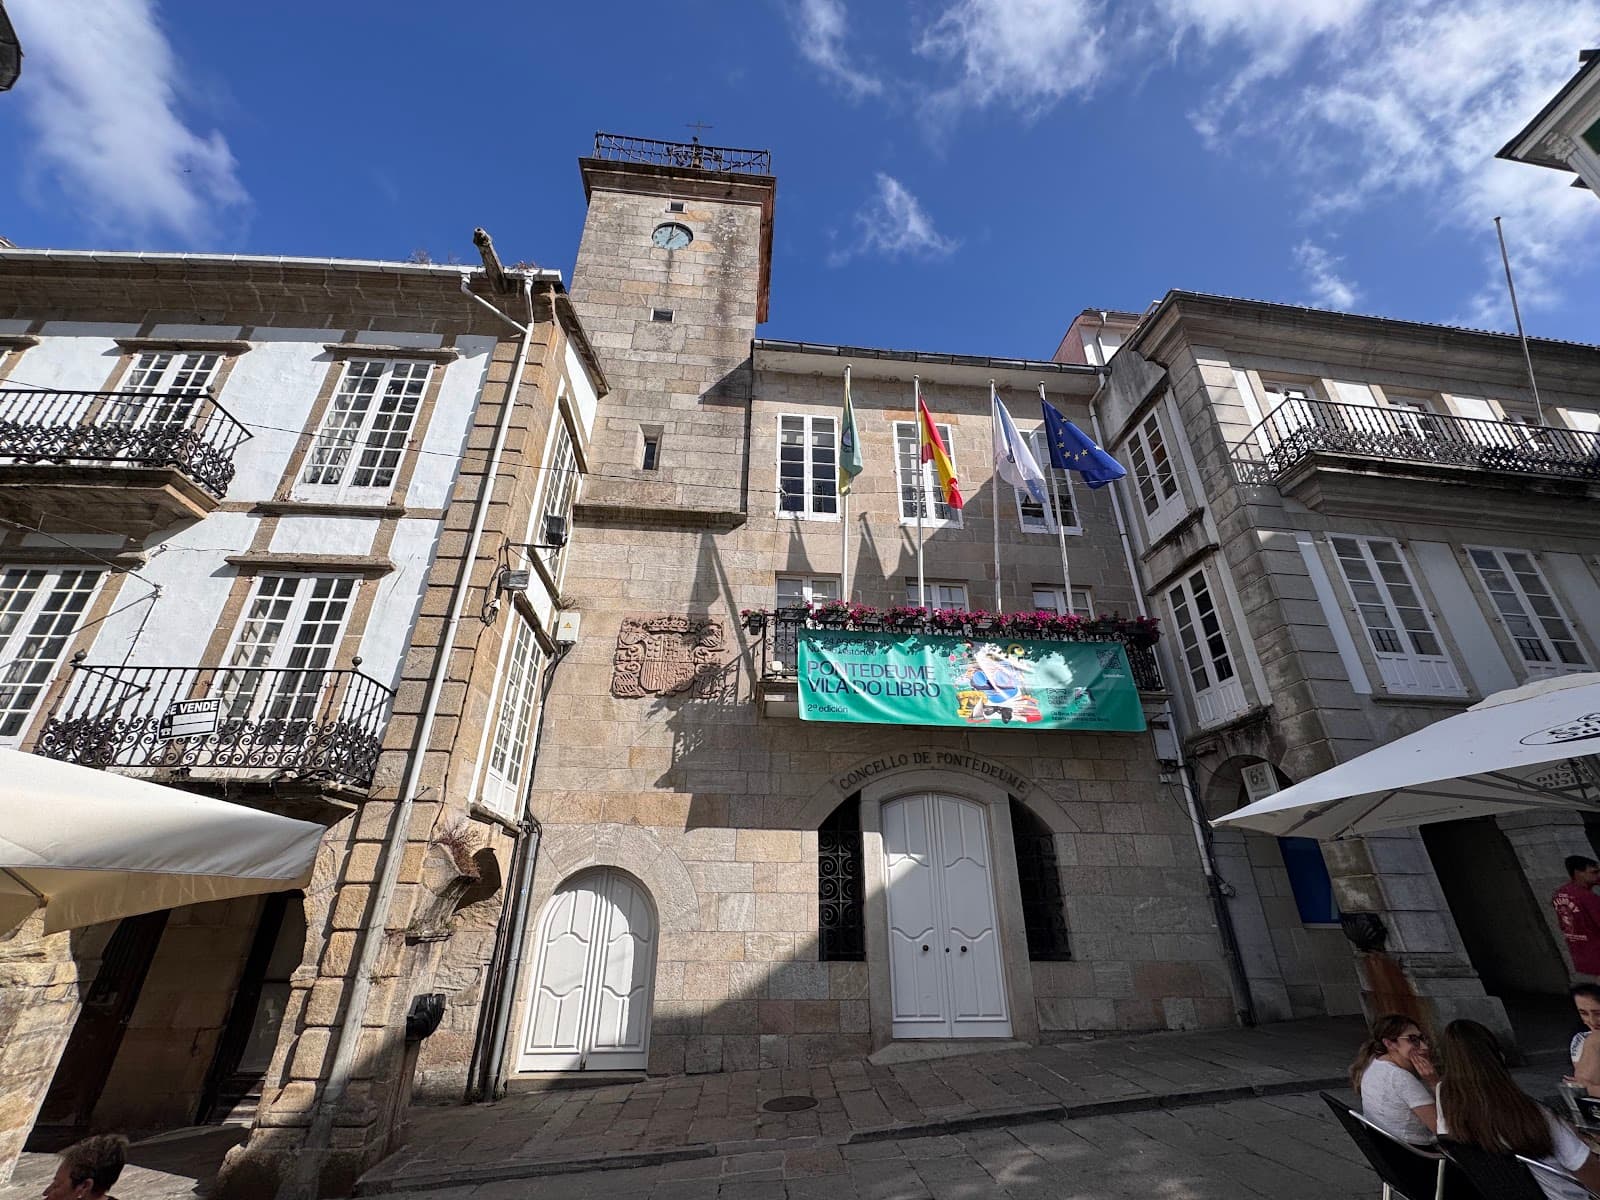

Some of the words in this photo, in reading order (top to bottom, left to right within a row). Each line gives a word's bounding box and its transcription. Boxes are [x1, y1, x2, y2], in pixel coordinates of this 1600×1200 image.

[807, 660, 936, 681] PONTEDEUME
[807, 677, 849, 694] VILA
[853, 680, 882, 696] DO
[886, 681, 941, 698] LIBRO
[180, 701, 218, 713] VENDE
[818, 704, 848, 713] edición
[839, 754, 908, 790] CONCELLO
[913, 752, 931, 764] DE
[936, 752, 1026, 793] PONTEDEUME
